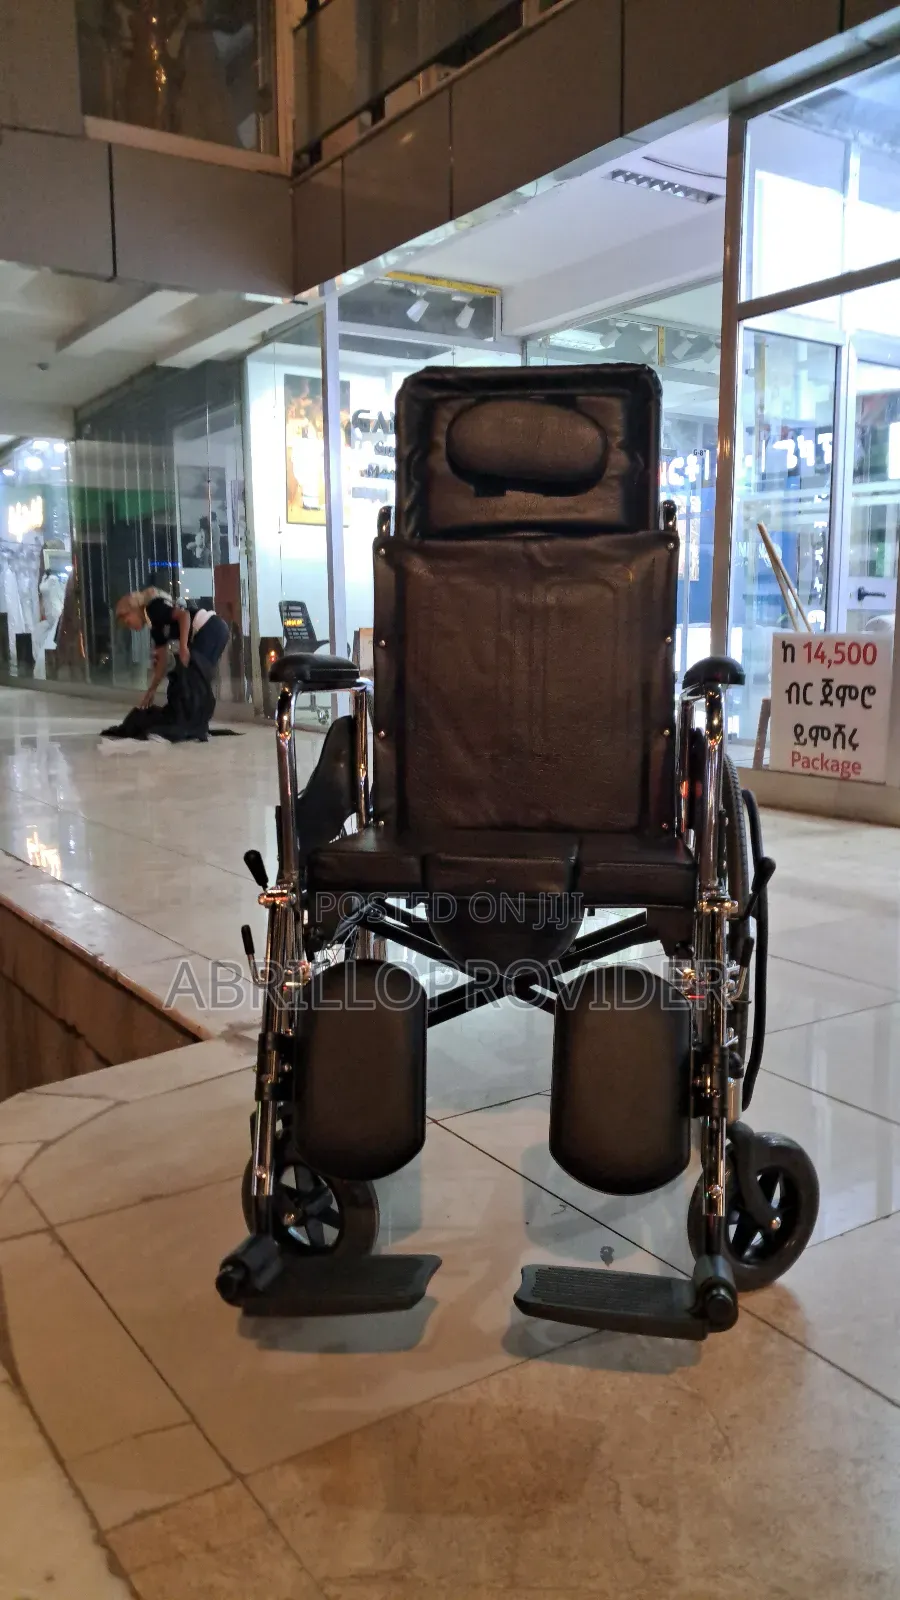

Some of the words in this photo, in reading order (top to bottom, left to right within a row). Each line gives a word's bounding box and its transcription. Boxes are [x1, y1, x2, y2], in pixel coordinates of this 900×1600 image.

[802, 641, 878, 669] 14,500
[785, 681, 814, 706] ብር
[791, 751, 862, 780] Package
